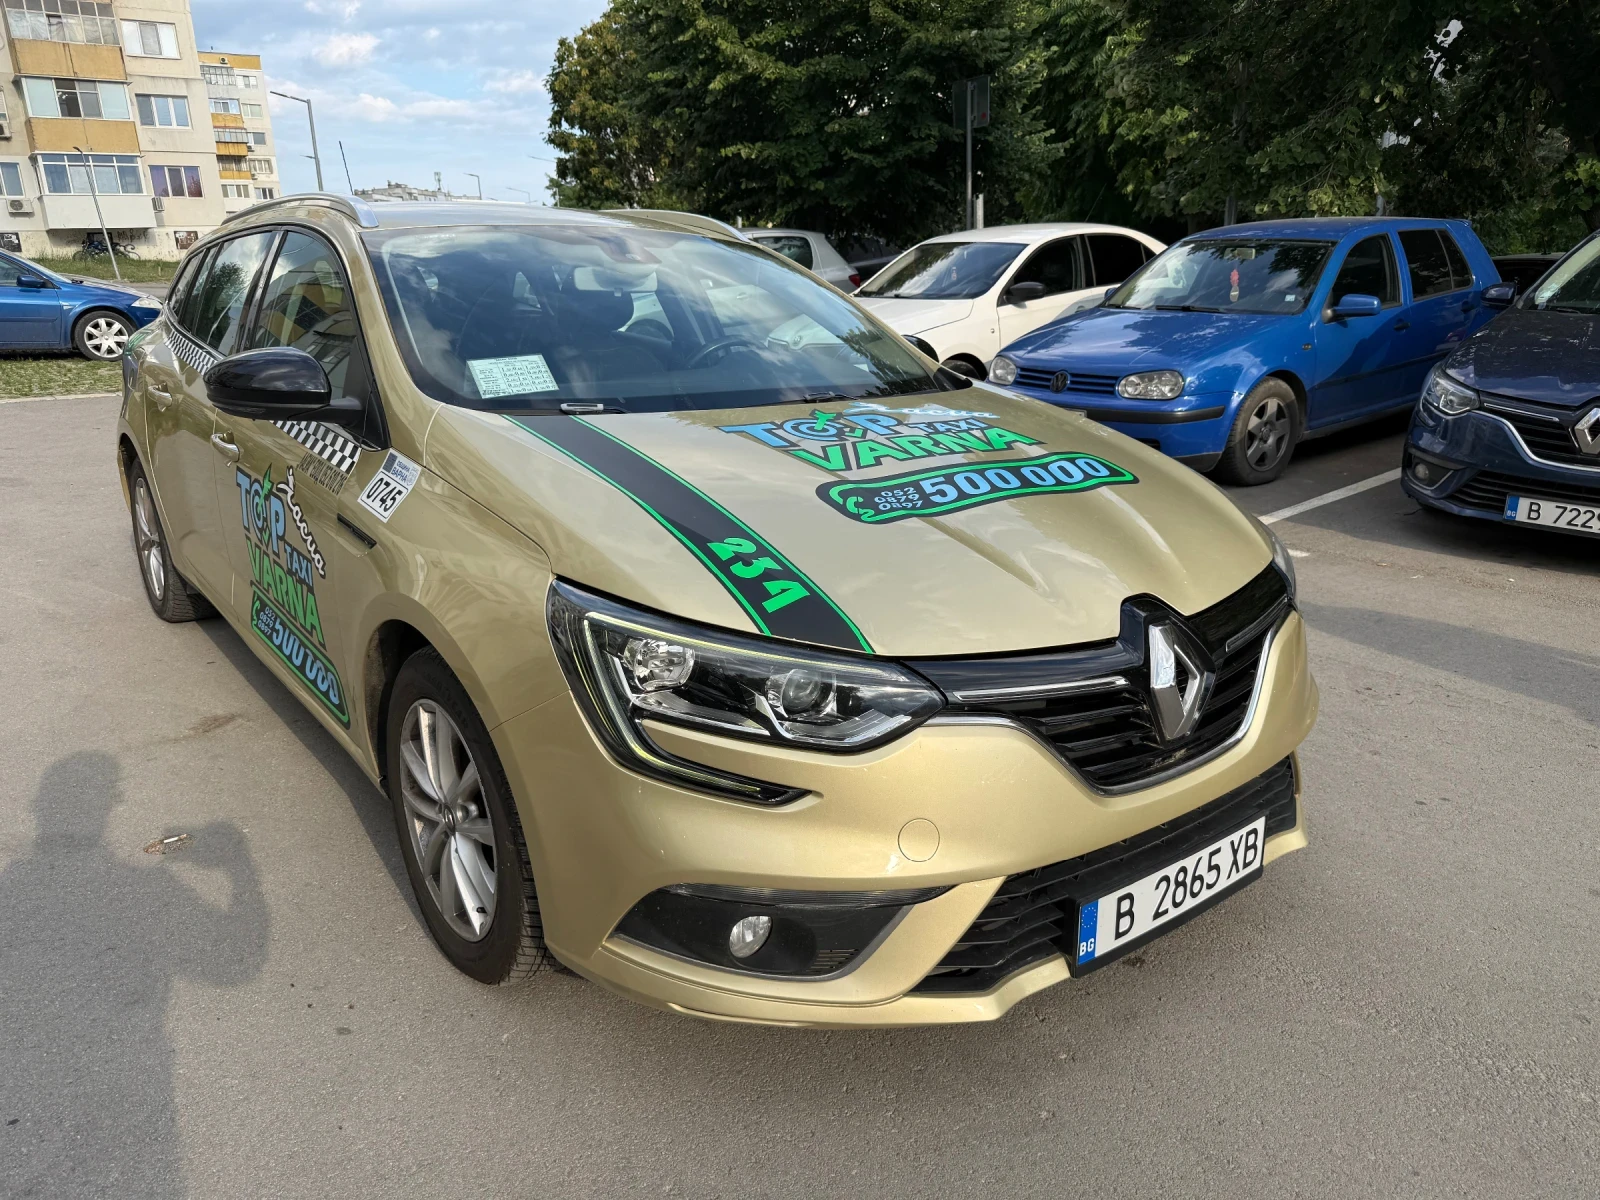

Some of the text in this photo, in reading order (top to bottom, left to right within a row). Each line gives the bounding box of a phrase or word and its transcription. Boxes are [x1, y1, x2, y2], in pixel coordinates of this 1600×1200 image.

[906, 418, 990, 434] TAXI
[786, 427, 1042, 472] VARNA
[366, 477, 403, 513] 0745
[880, 487, 917, 498] 052
[919, 458, 1110, 504] 500 000
[874, 493, 920, 504] 0879
[1526, 501, 1542, 521] B
[283, 542, 314, 588] TAXI
[706, 537, 811, 614] 234
[245, 536, 326, 650] VARNA
[260, 611, 274, 628] 0879
[265, 606, 276, 621] 052
[1114, 827, 1259, 941] B 2865 XB
[1079, 937, 1095, 956] BG
